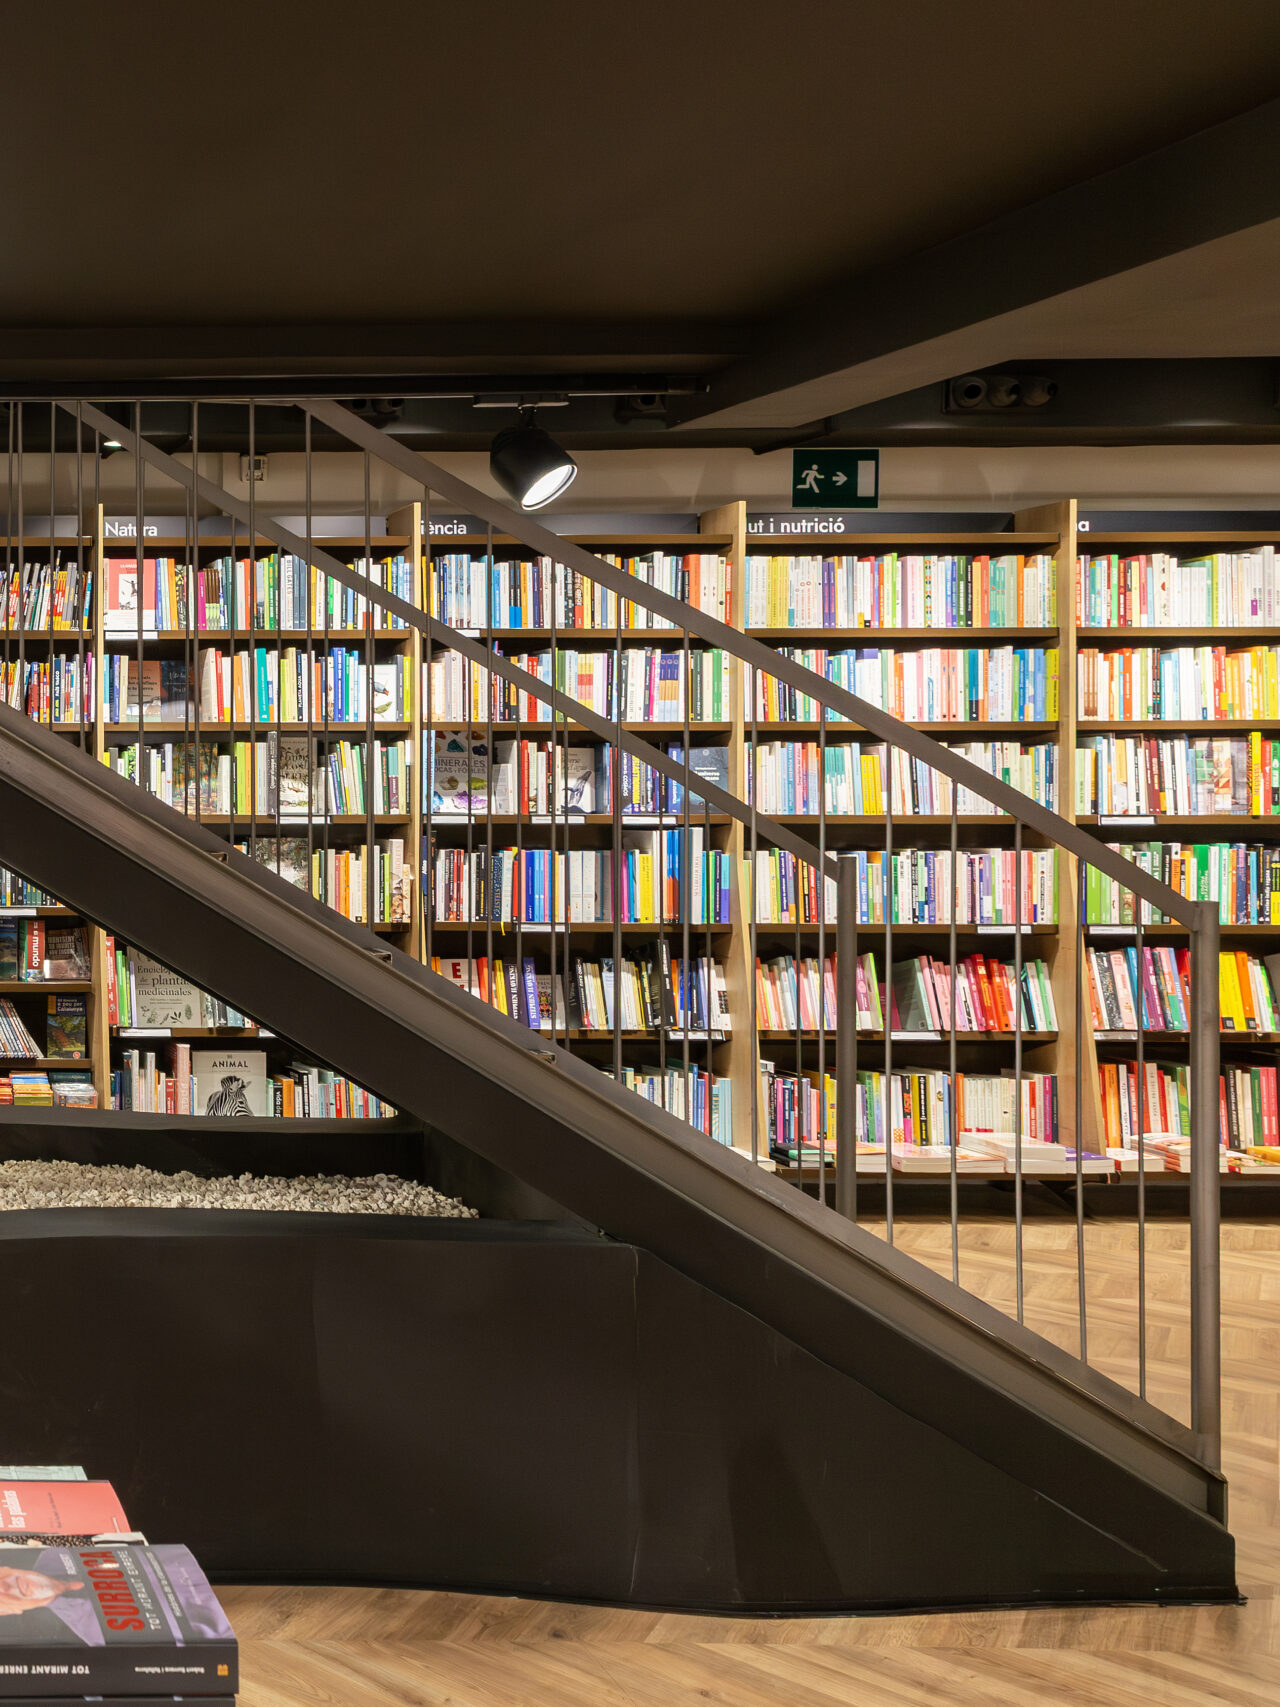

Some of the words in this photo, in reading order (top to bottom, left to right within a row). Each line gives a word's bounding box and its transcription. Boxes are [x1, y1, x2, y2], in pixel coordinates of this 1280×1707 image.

[420, 519, 467, 535] iència
[769, 518, 774, 533] i
[780, 518, 845, 533] nutrició
[434, 759, 485, 768] INERAES
[138, 987, 192, 997] medicinales
[528, 995, 537, 1020] STEPHEN
[211, 1060, 249, 1069] ANIMAL
[78, 1551, 145, 1631] SURROCA
[130, 1577, 152, 1610] MIRANT
[145, 1612, 162, 1631] TOT
[31, 1664, 71, 1675] MIRANT
[73, 1664, 92, 1675] TOT
